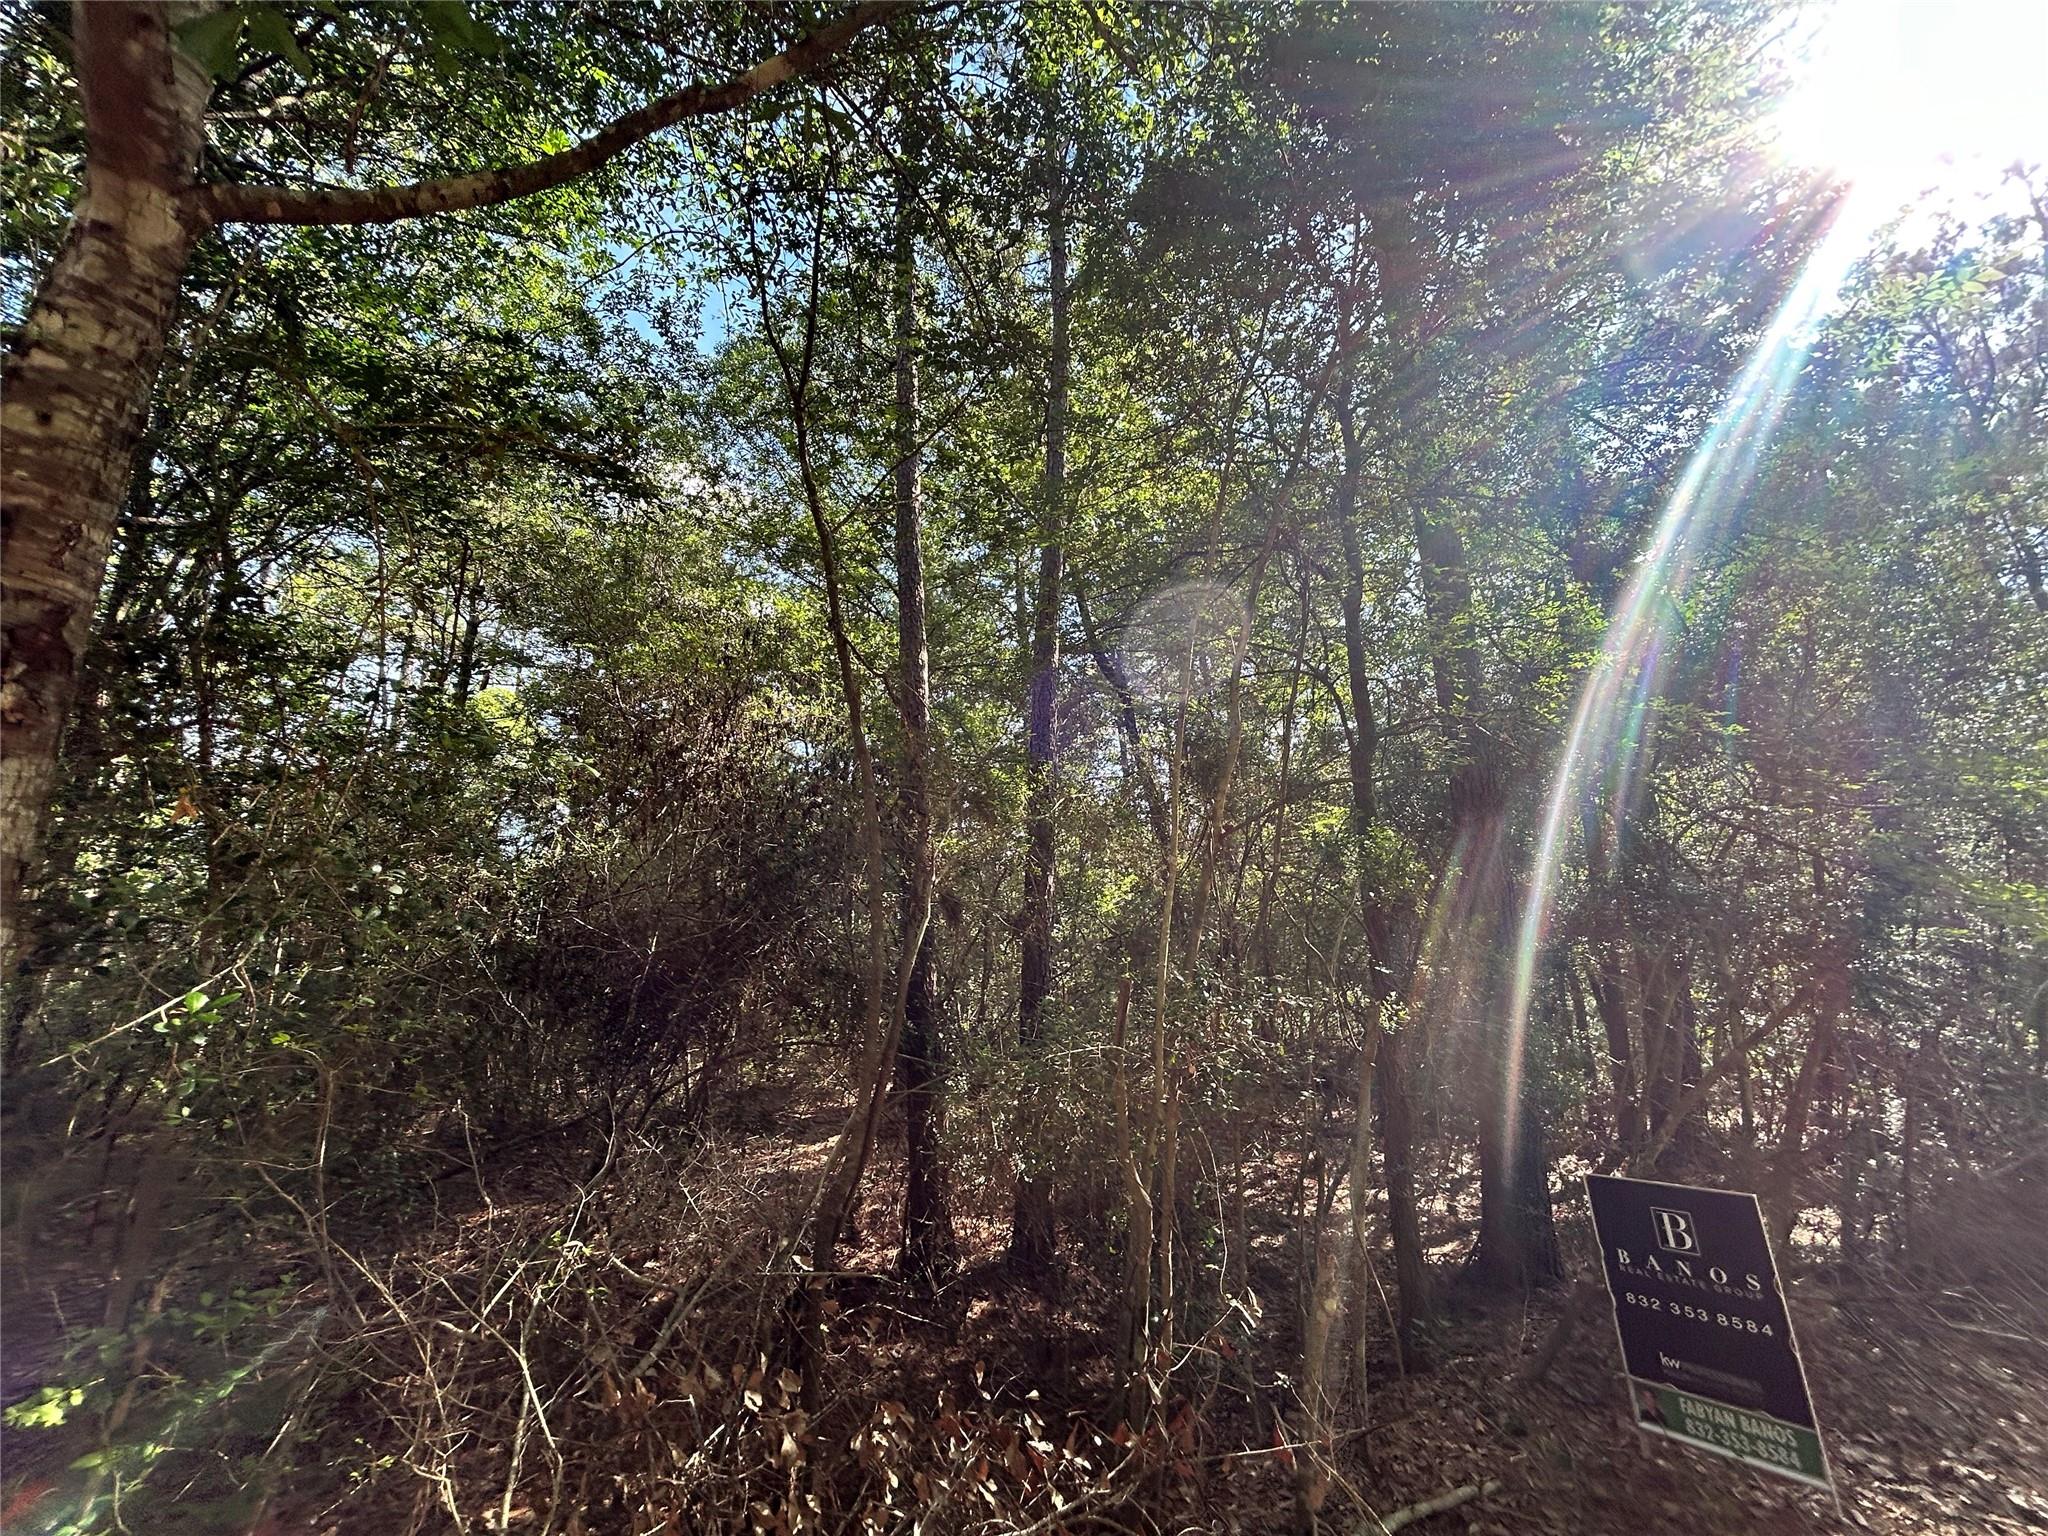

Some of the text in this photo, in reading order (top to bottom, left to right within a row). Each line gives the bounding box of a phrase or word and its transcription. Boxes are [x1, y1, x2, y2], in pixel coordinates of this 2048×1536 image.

[1655, 1211, 1693, 1250] B
[1616, 1248, 1761, 1291] BANOS
[1619, 1264, 1652, 1279] REAL
[1713, 1284, 1764, 1300] GROUP
[1625, 1292, 1774, 1337] 832 353 8584
[1659, 1351, 1681, 1369] kw
[1679, 1397, 1799, 1448] FABYAN BANOS
